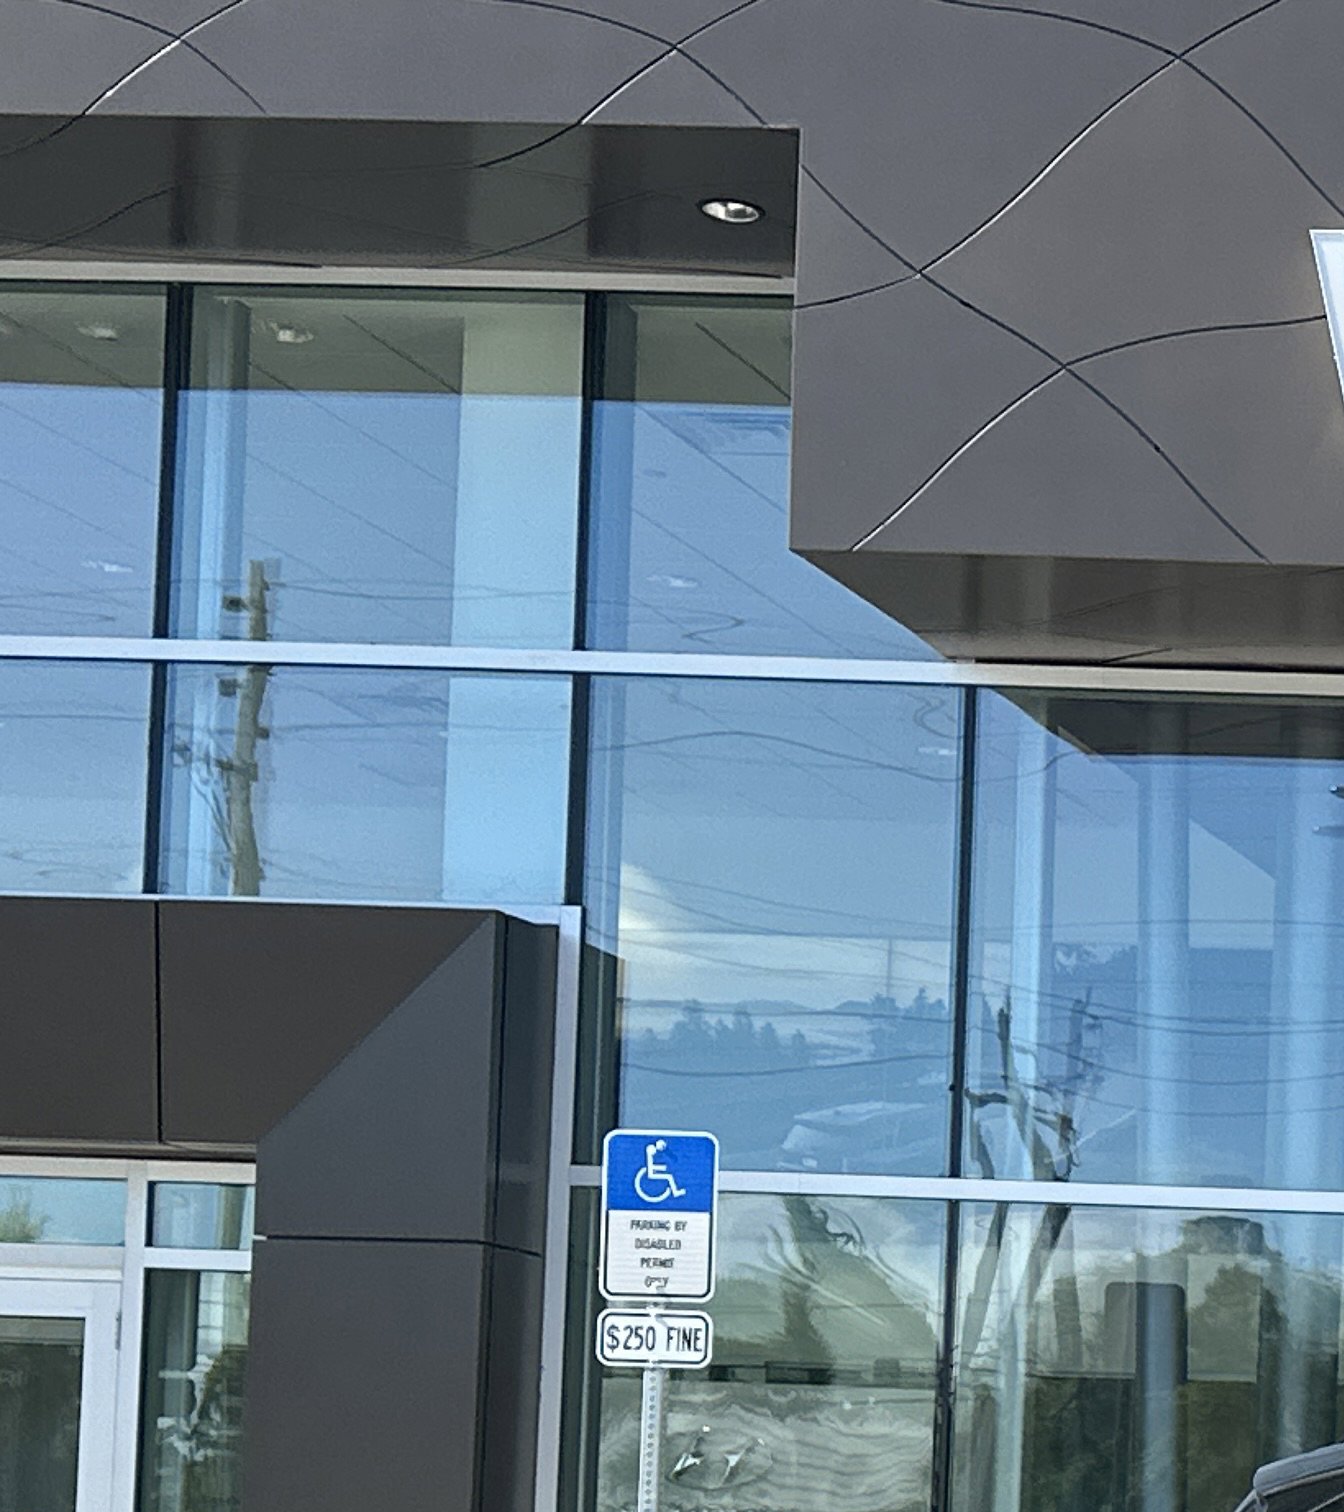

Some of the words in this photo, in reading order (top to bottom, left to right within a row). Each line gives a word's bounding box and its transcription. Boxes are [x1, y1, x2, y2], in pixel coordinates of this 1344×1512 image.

[674, 1220, 687, 1232] BY
[606, 1323, 656, 1353] $250
[666, 1325, 703, 1352] FINE
